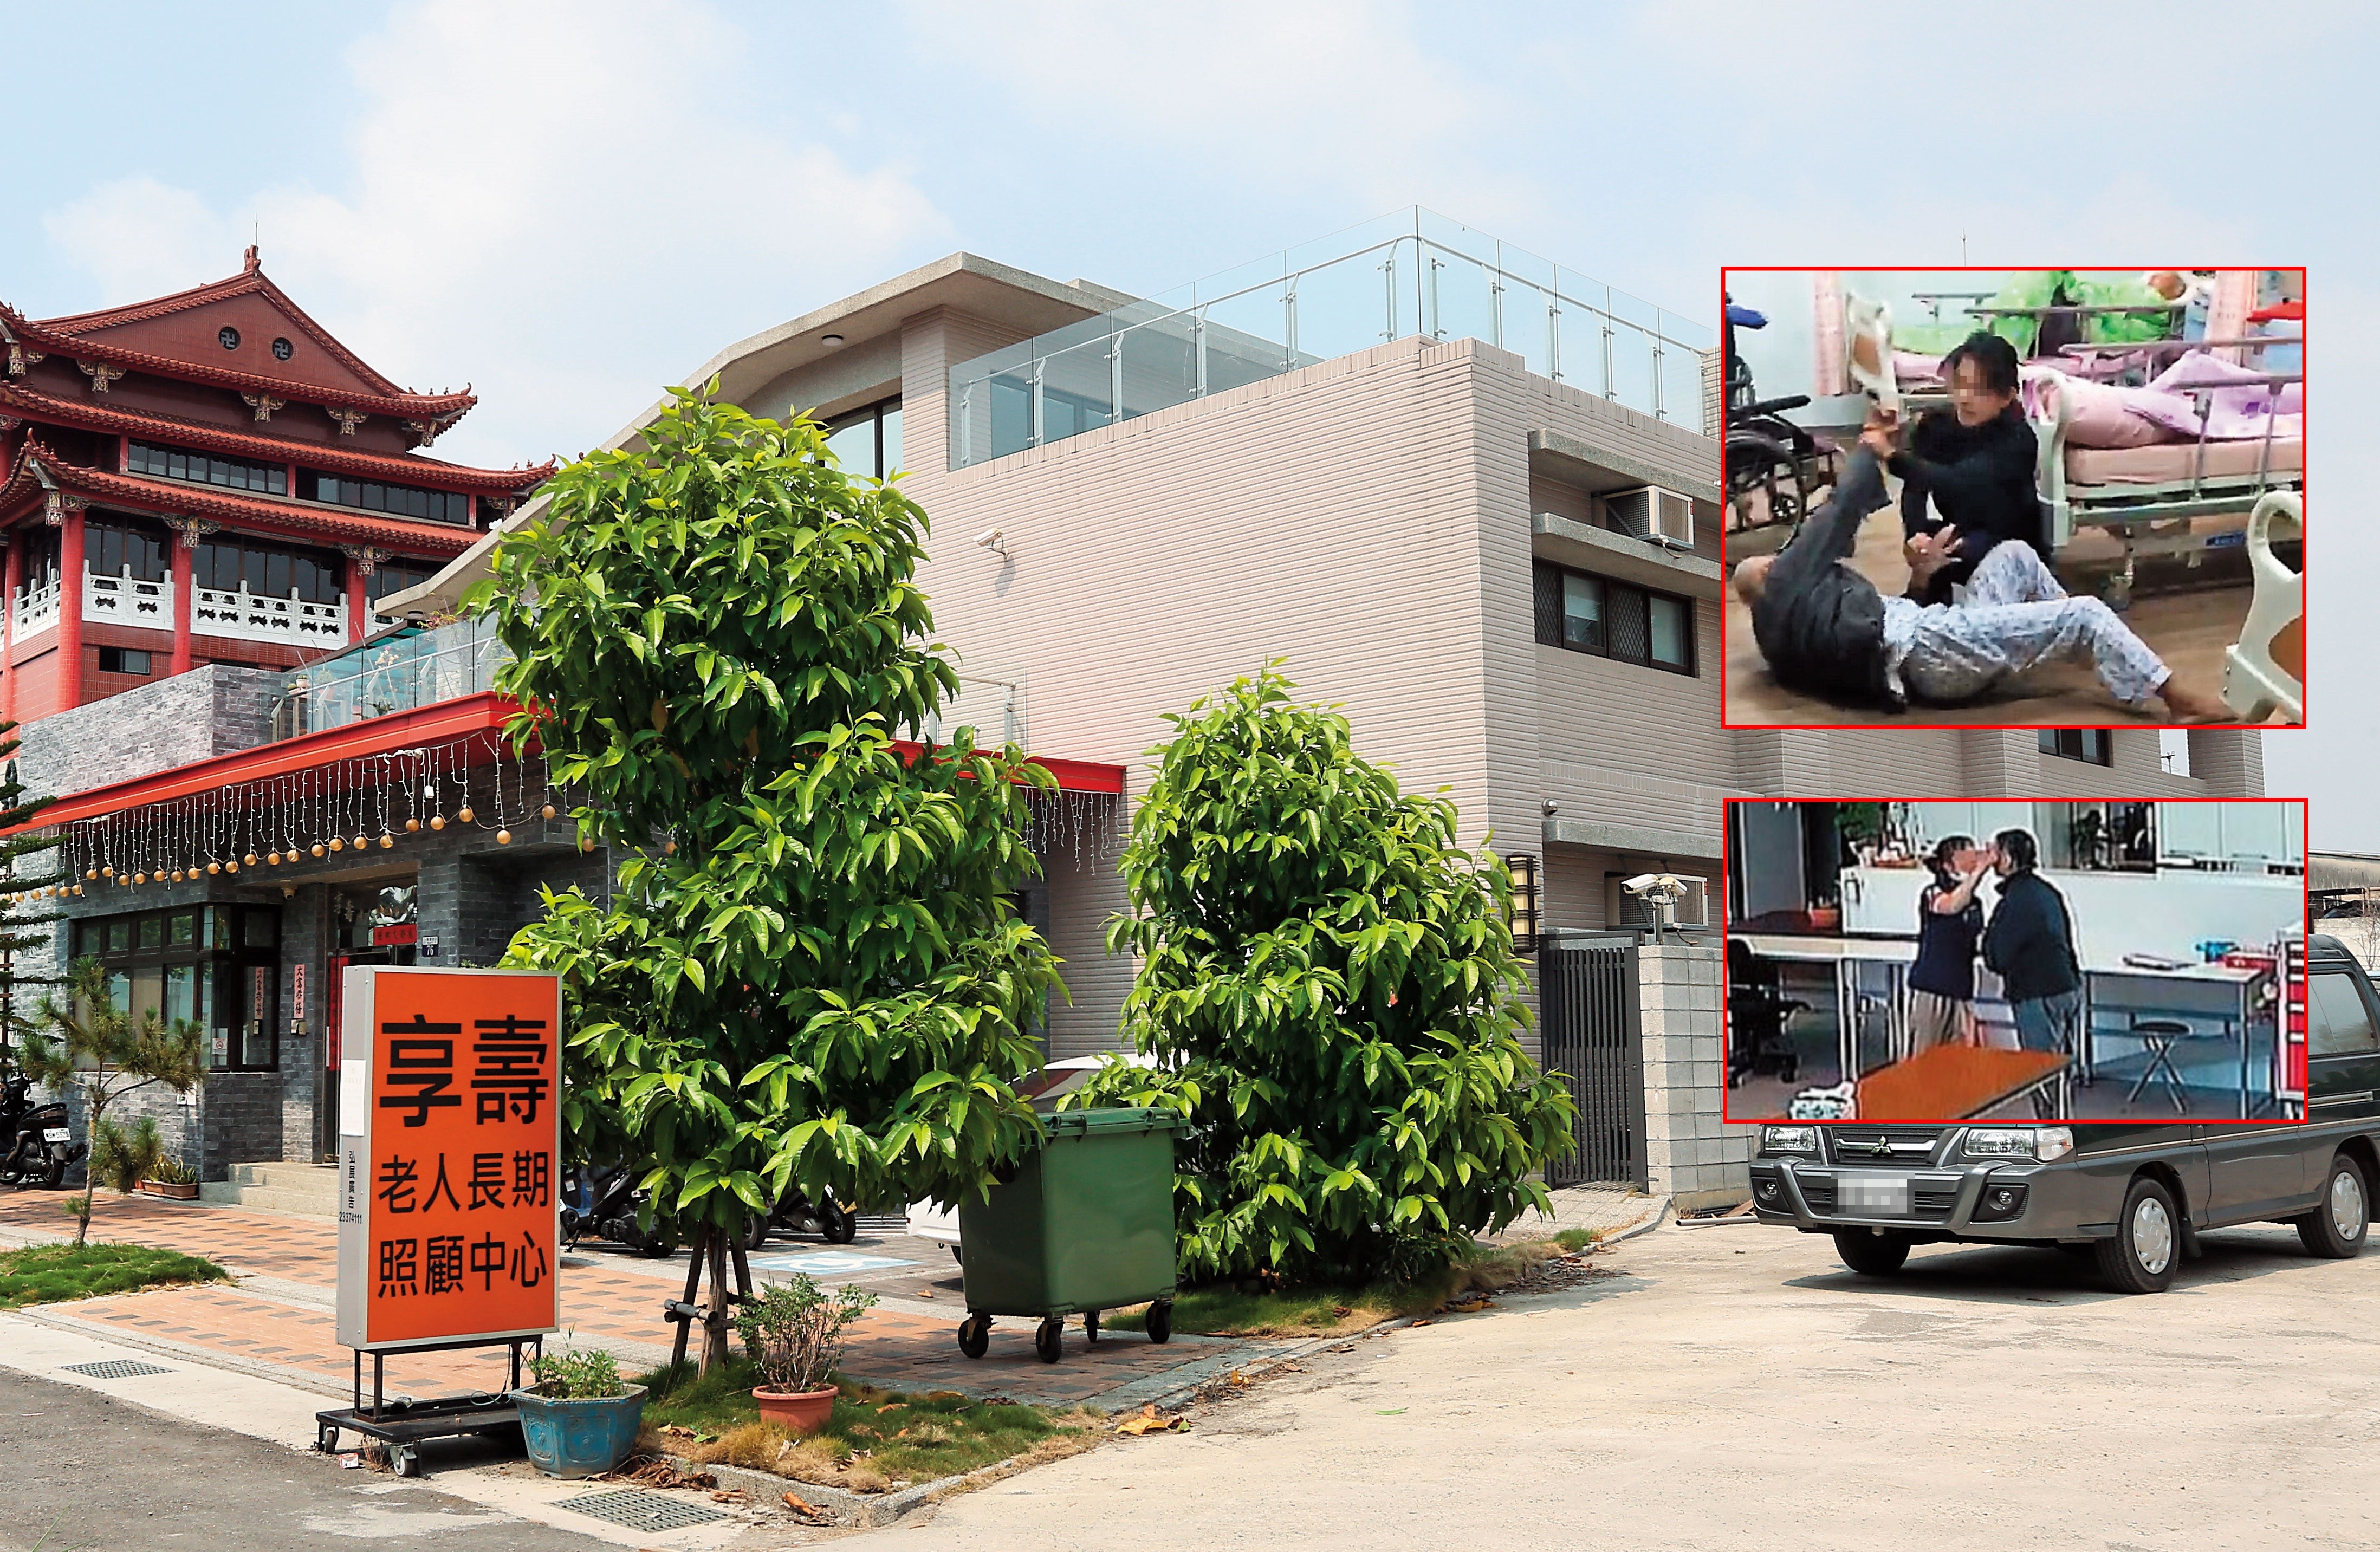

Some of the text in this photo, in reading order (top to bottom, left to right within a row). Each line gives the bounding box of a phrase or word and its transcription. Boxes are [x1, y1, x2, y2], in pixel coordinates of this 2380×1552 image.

[427, 945, 434, 956] 76
[379, 1014, 549, 1127] 享壽
[379, 1150, 548, 1213] 老人長期
[339, 1211, 362, 1224] 23374111
[378, 1230, 547, 1298] 照顧中心
